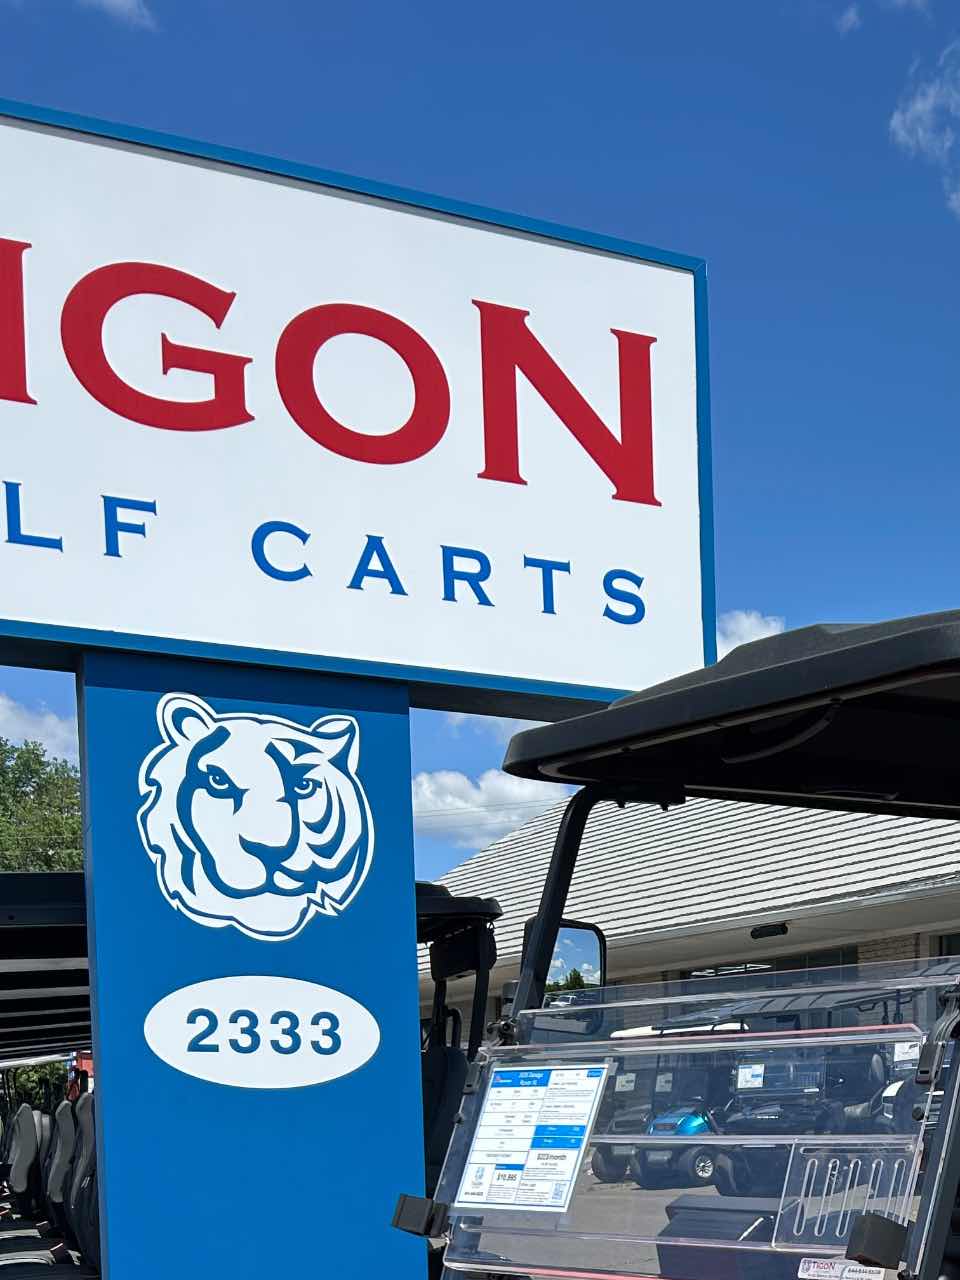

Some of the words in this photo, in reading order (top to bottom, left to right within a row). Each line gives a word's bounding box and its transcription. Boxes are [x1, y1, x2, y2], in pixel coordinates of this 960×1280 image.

[251, 521, 646, 626] CARTS
[186, 1008, 342, 1055] 2333
[812, 1261, 835, 1271] TIGON
